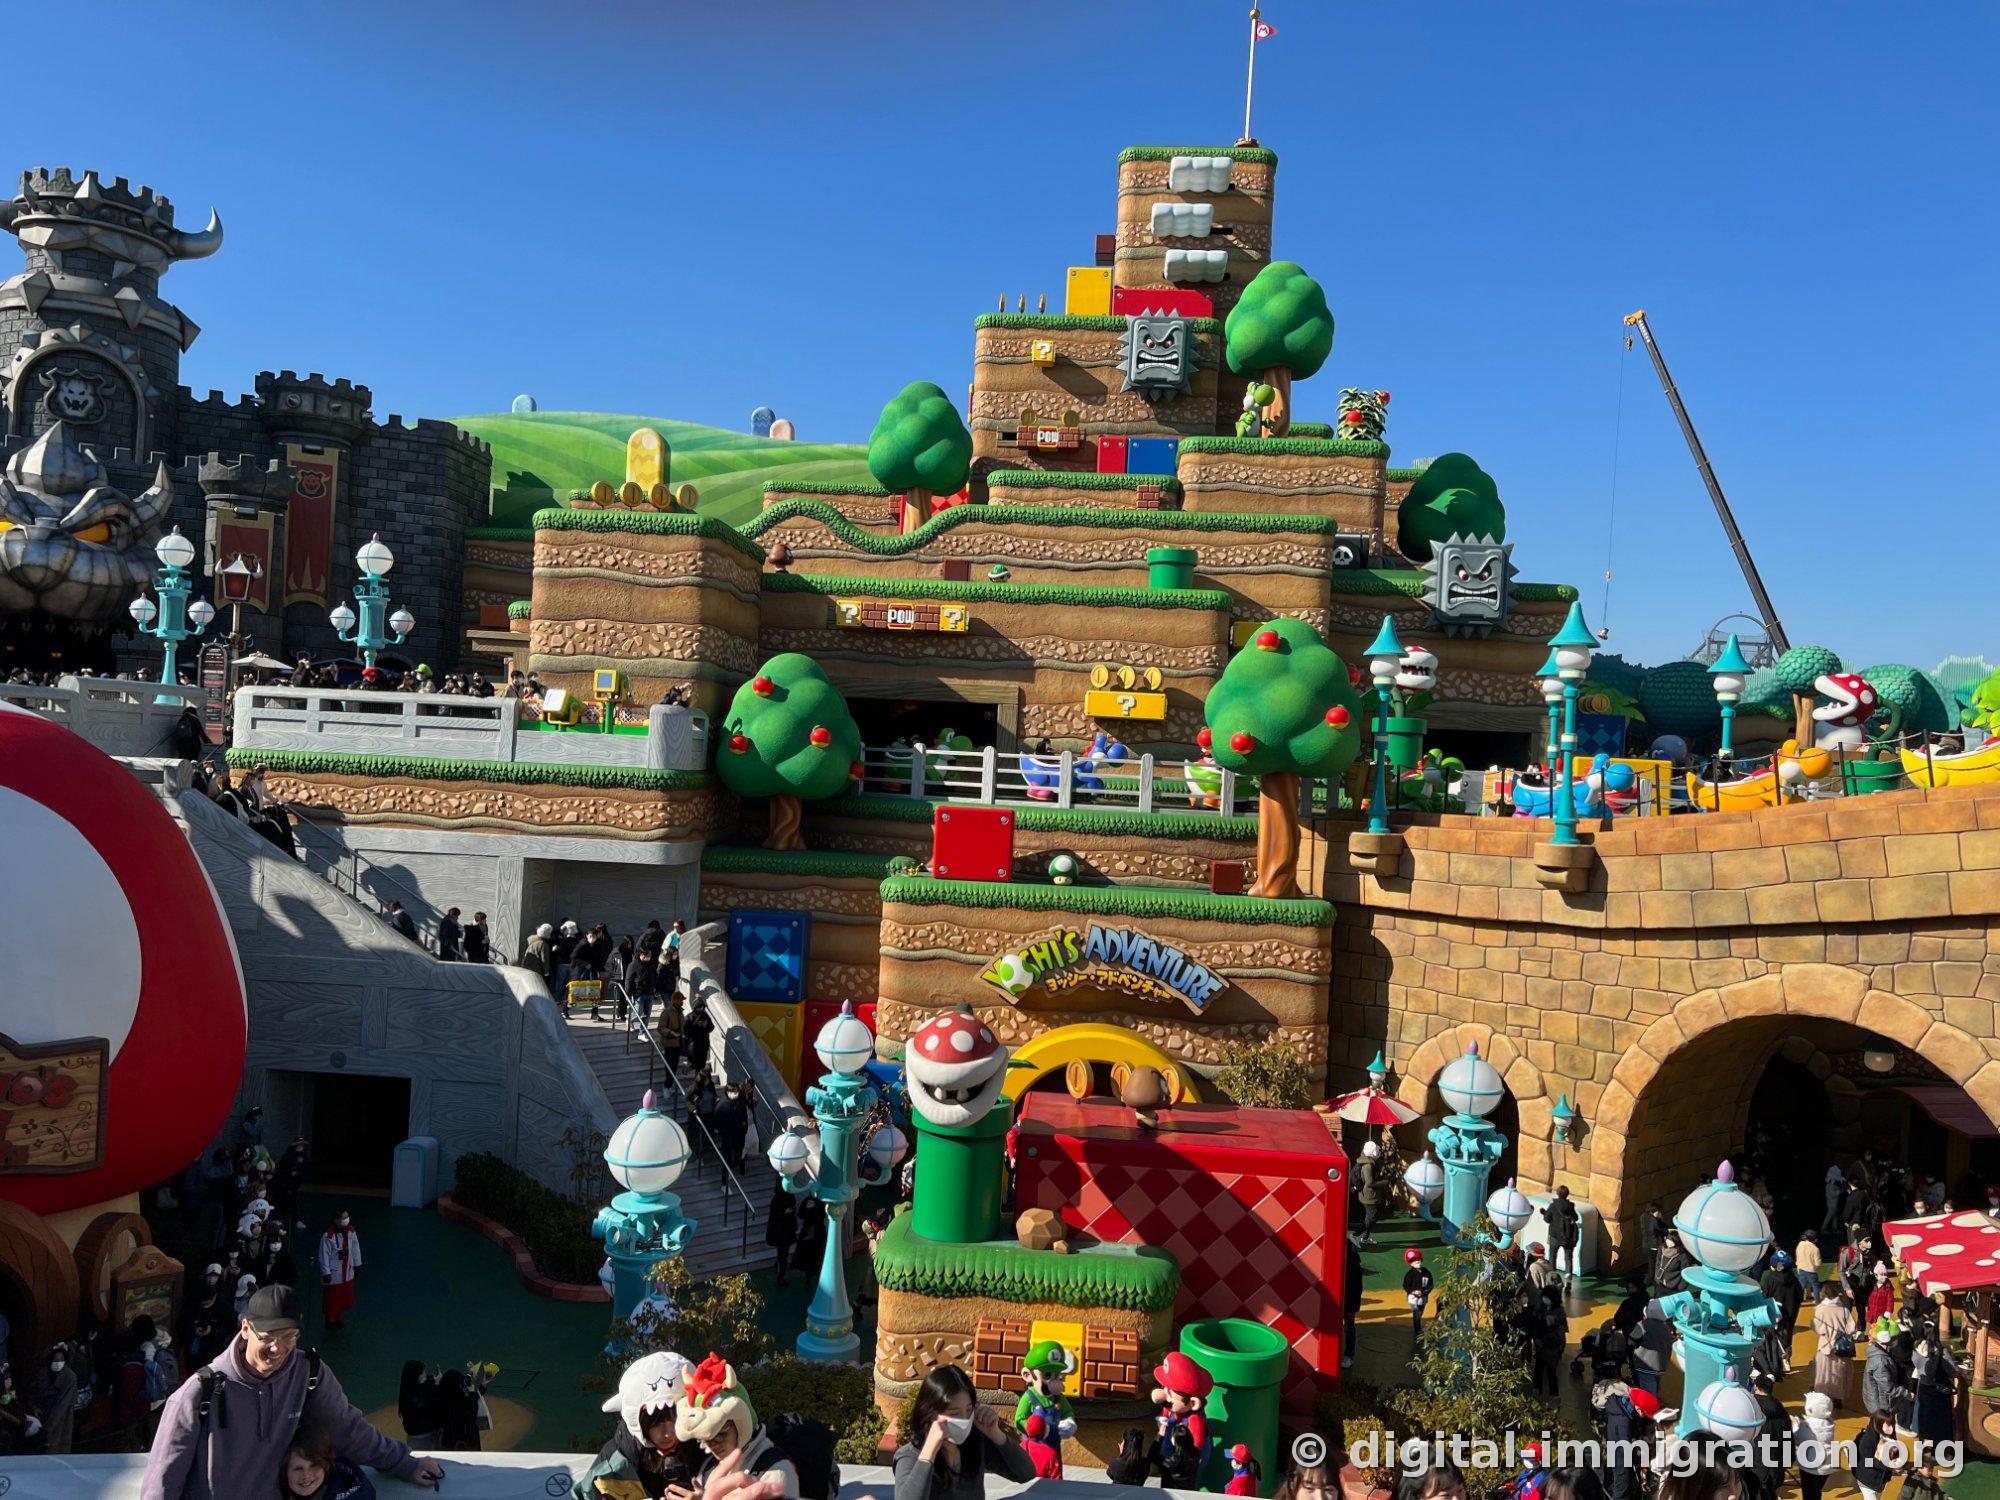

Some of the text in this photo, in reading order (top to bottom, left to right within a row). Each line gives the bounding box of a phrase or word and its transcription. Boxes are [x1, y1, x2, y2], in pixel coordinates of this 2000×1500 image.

[1037, 430, 1059, 442] POW
[840, 603, 962, 630] ? POW ?
[1117, 695, 1135, 716] ?
[1084, 924, 1223, 1008] ADVENTURE
